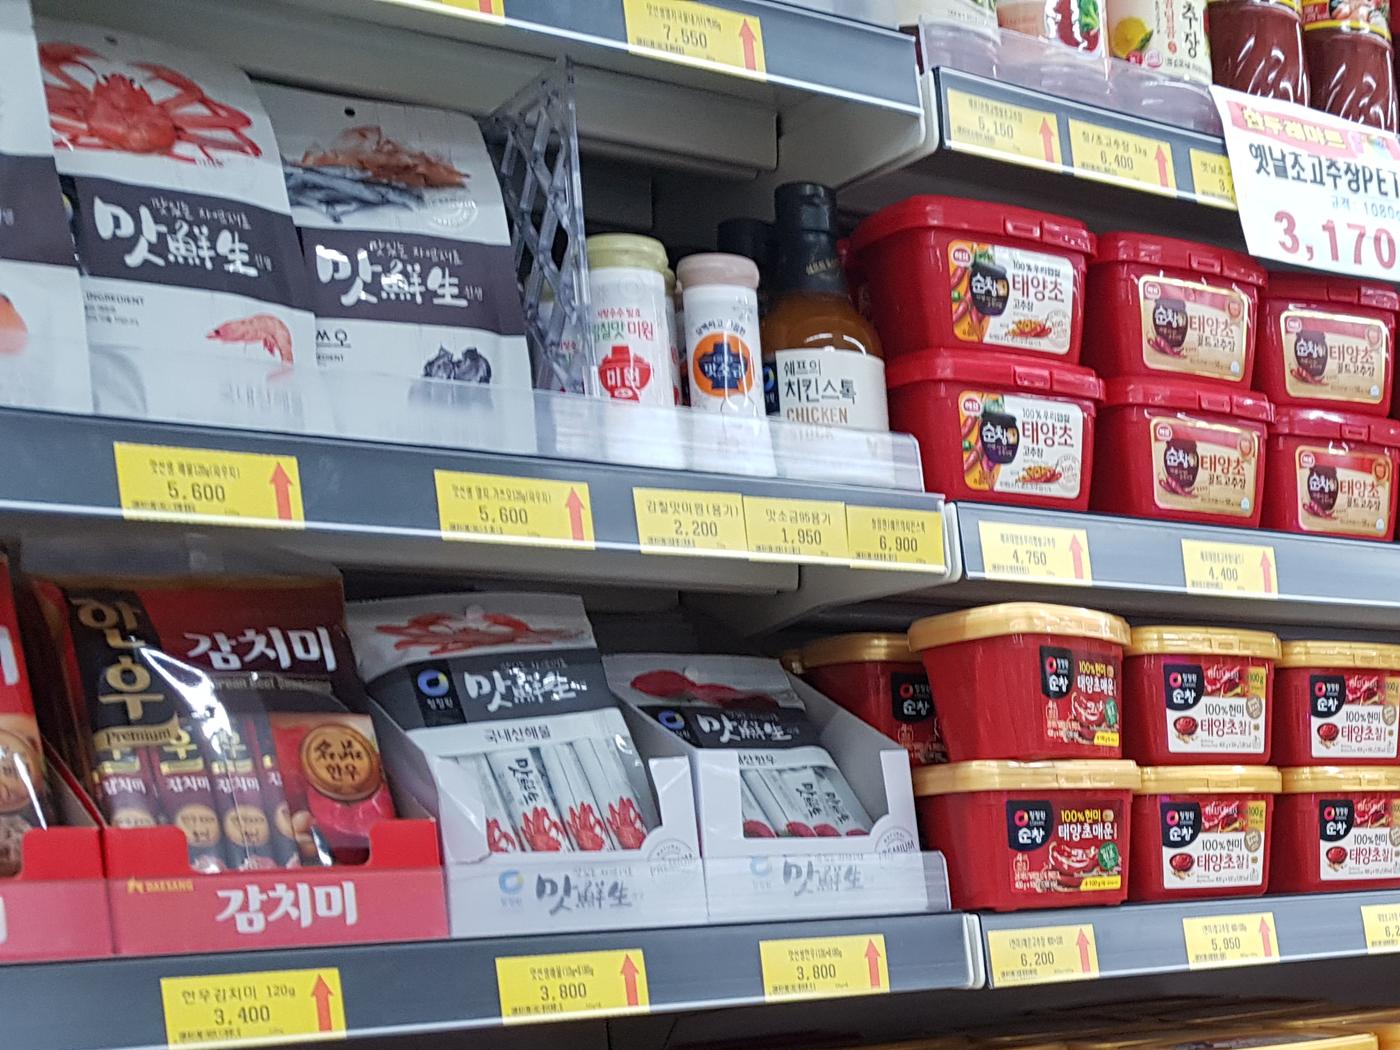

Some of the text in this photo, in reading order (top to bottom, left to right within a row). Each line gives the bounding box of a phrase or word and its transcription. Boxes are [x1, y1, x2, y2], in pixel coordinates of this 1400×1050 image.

[662, 23, 708, 48] 7,550
[1274, 210, 1396, 270] 3,170
[1012, 275, 1064, 303] 태양초
[627, 323, 654, 341] 미원
[785, 379, 857, 404] 치킨스톡
[787, 407, 848, 424] CHICKEN
[1021, 419, 1074, 449] 태양초
[1200, 453, 1246, 478] 태양초
[167, 480, 226, 503] 5,600
[478, 505, 529, 525] 5,600
[674, 520, 718, 537] 2,200
[781, 528, 822, 545] 1,950
[879, 536, 918, 552] 6,900
[1012, 550, 1047, 567] 4,750
[1208, 566, 1238, 582] 4,400
[183, 626, 336, 672] 감치미
[1048, 676, 1069, 692] 순창
[1172, 689, 1196, 705] 순창
[105, 727, 177, 746] Premium
[482, 724, 553, 746] 국내산해물
[1018, 828, 1045, 845] 순창
[1169, 826, 1194, 842] 순창
[216, 880, 359, 934] 감치미
[1211, 936, 1241, 952] 5,950
[1020, 951, 1055, 966] 6,200
[796, 964, 837, 981] 3,800
[267, 984, 296, 999] 120g
[540, 982, 587, 1000] 3,800
[213, 1004, 271, 1025] 3,400
